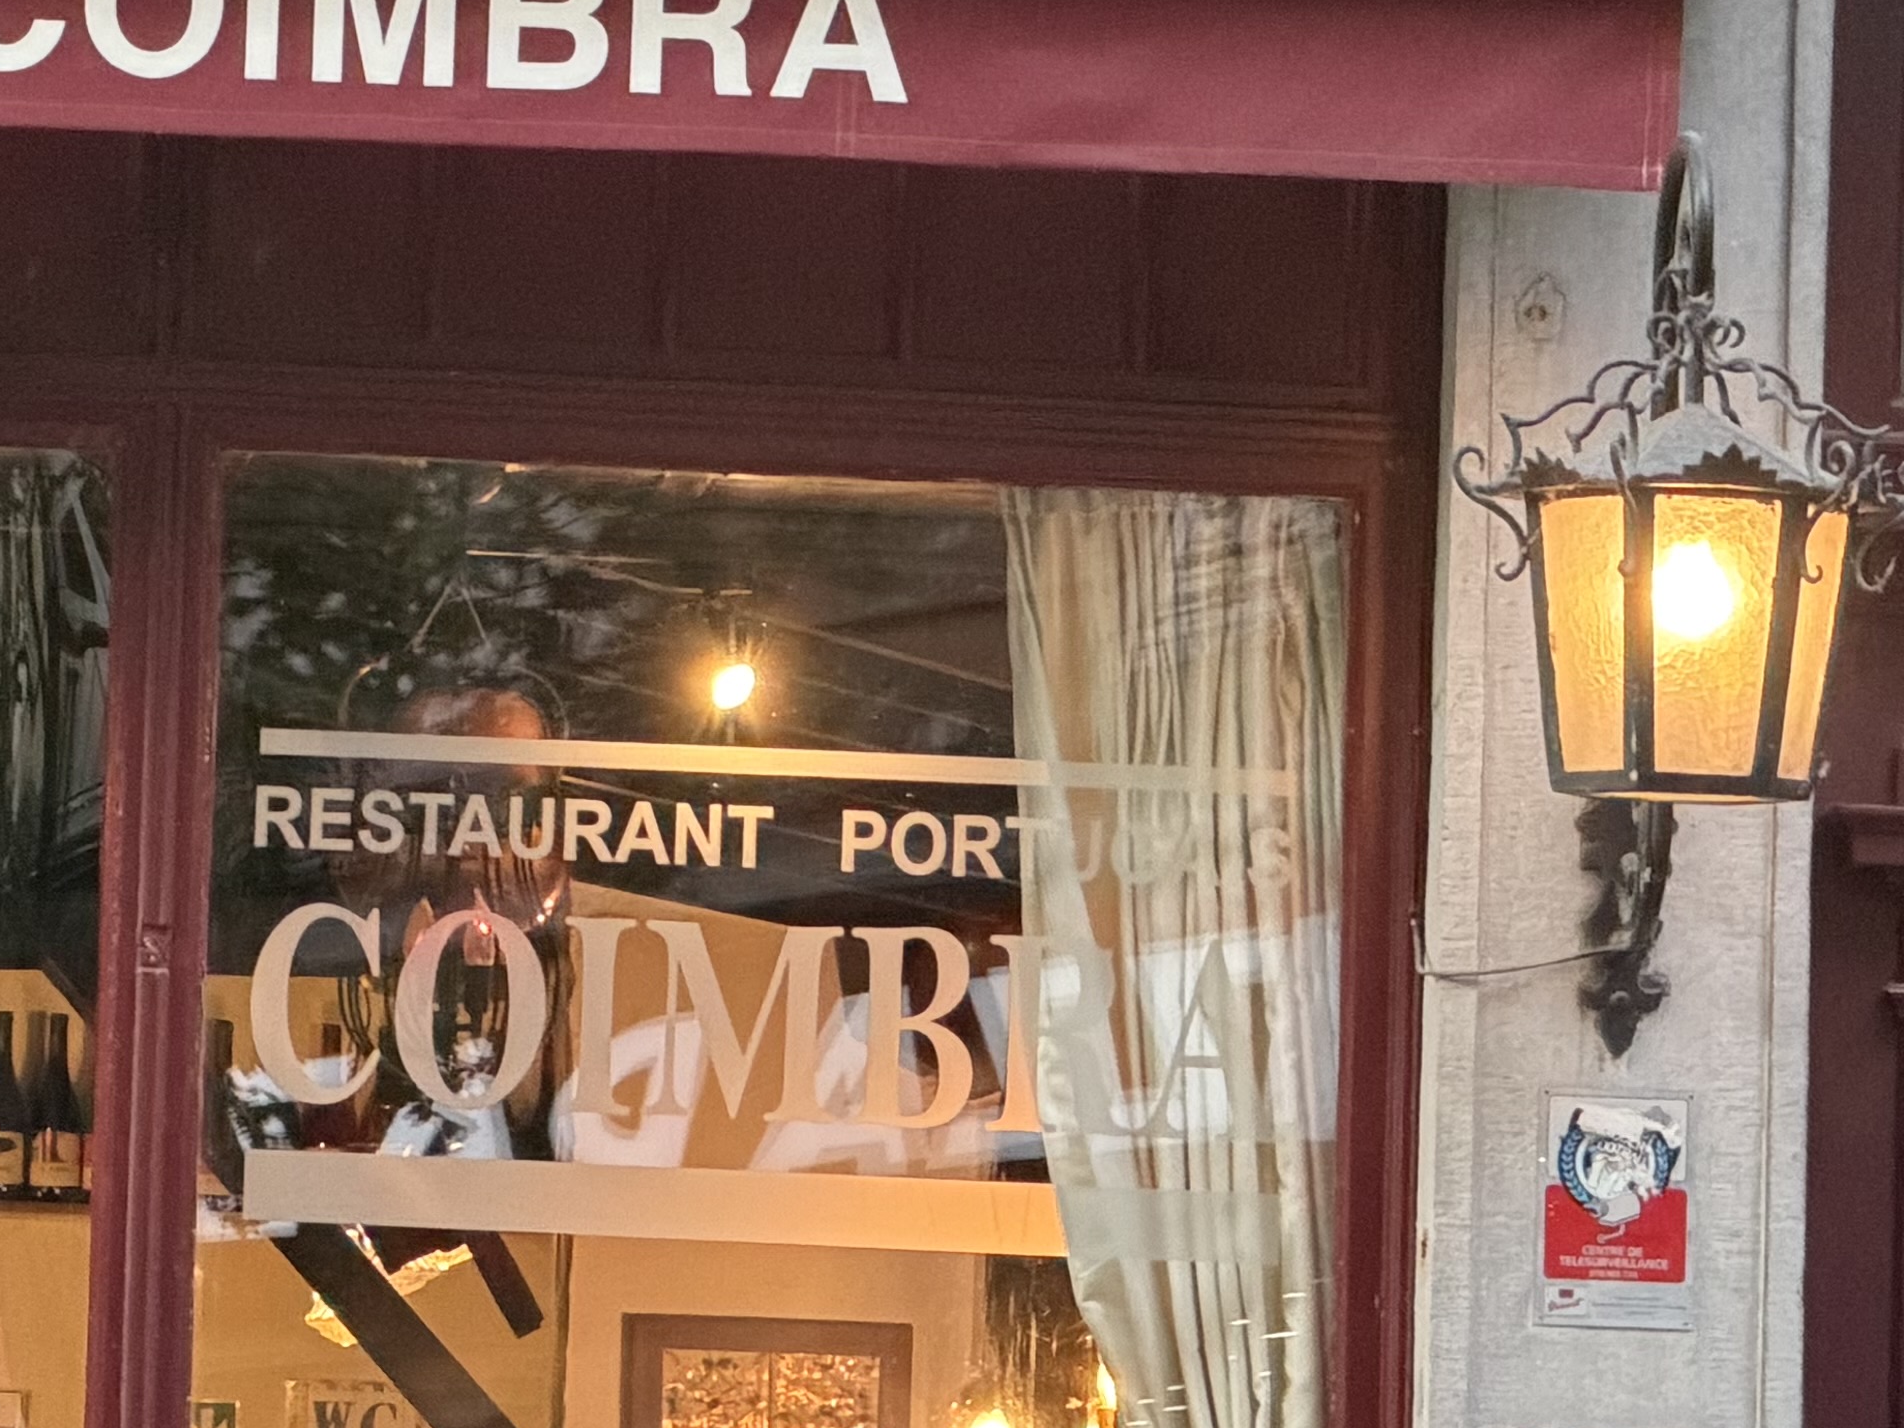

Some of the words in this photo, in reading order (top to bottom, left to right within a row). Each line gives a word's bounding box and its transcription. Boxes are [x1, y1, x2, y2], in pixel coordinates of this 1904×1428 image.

[252, 784, 775, 869] RESTAURANT
[840, 809, 1293, 890] PORTUGS
[249, 900, 1282, 1142] COIMBRA
